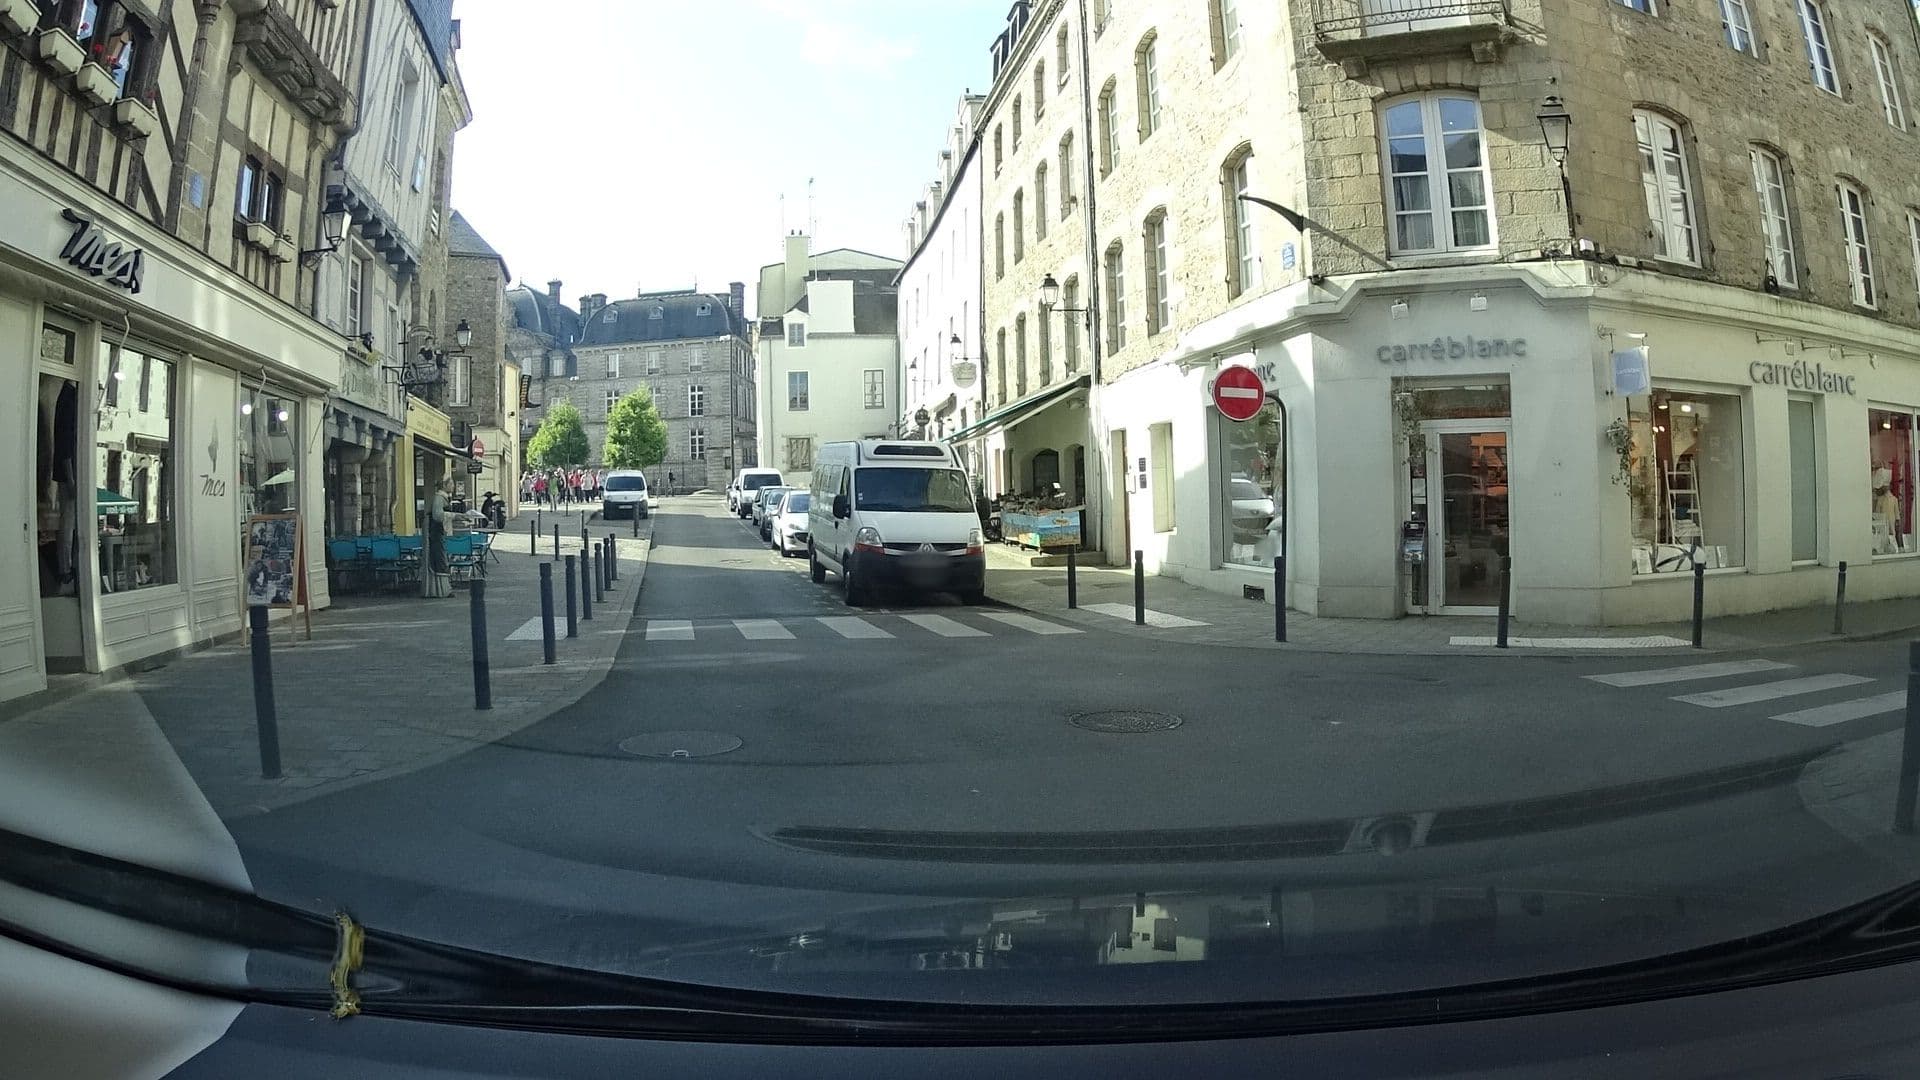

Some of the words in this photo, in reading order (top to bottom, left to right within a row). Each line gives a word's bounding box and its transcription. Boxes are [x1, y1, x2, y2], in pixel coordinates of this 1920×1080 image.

[1376, 335, 1528, 362] carréblanc
[1749, 360, 1857, 395] carréblanc
[200, 474, 226, 497] mcs
